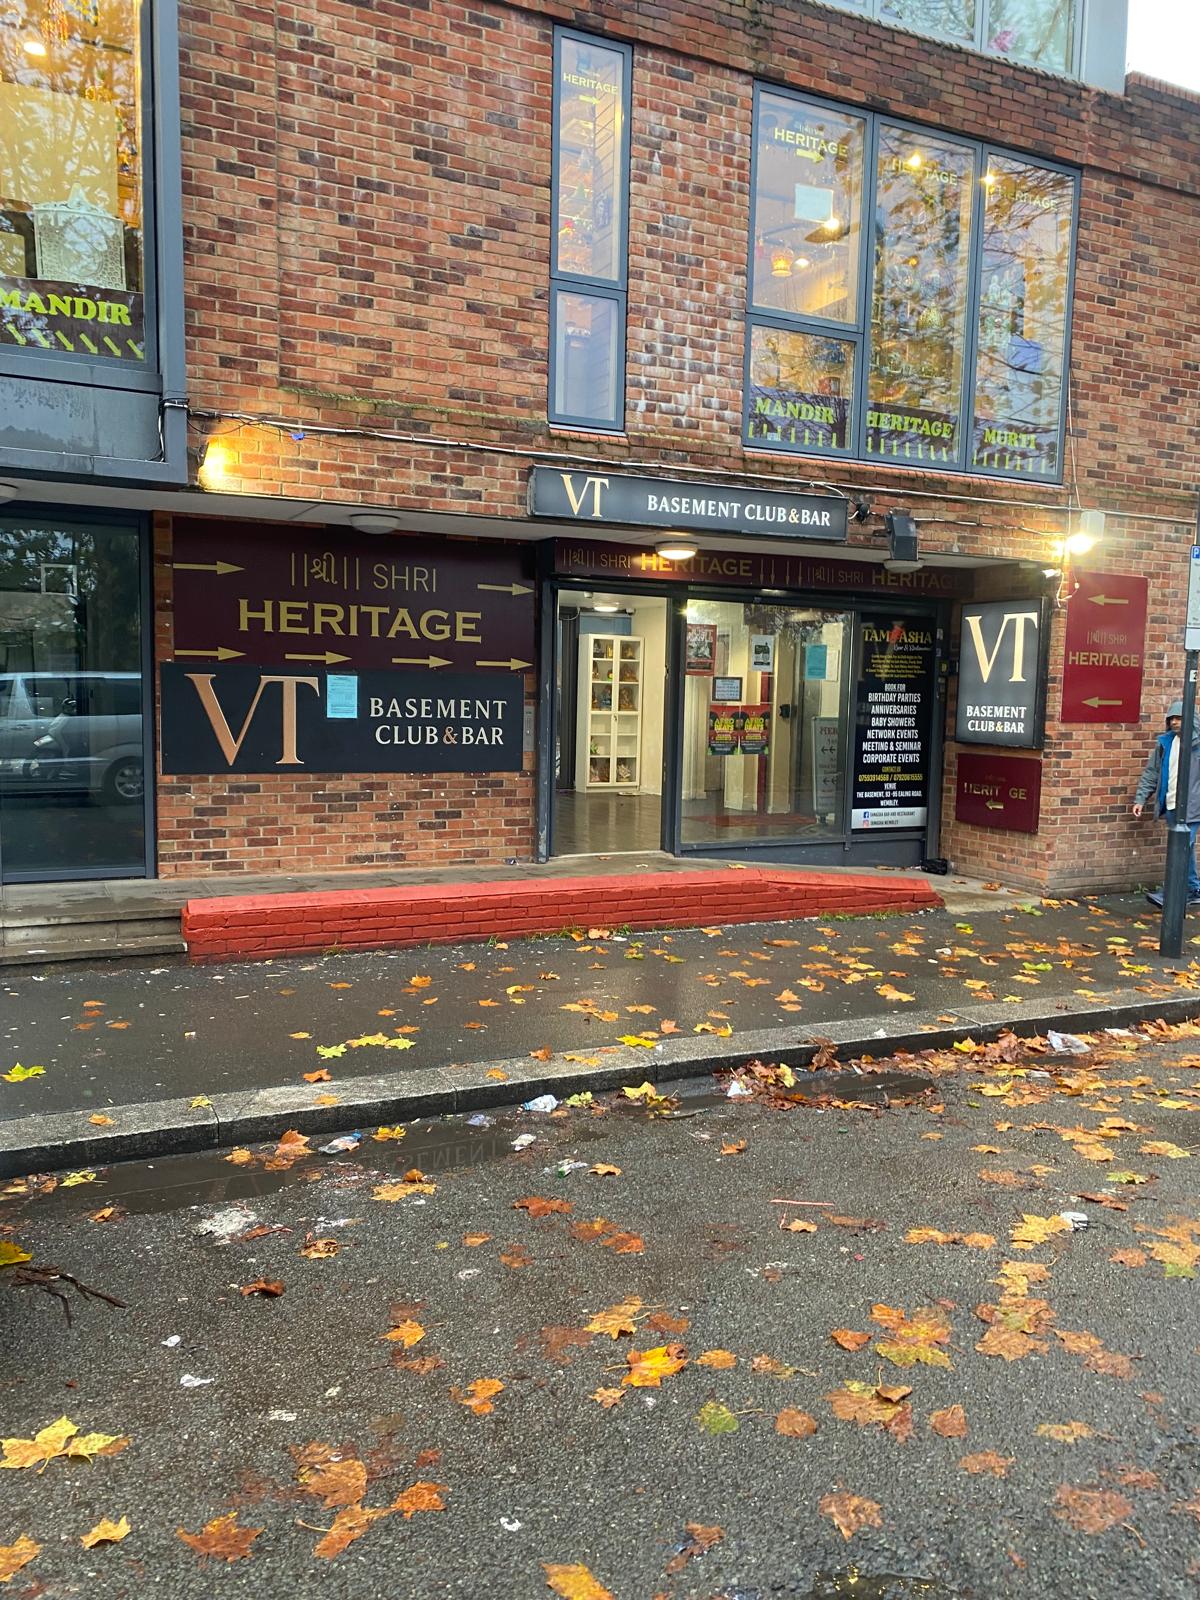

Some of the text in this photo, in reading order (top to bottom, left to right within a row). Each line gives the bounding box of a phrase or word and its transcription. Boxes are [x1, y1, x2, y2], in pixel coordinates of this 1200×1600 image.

[563, 72, 618, 95] HERITAGE
[774, 128, 848, 157] HERITAGE
[892, 158, 957, 186] HETAGE
[0, 287, 132, 326] MANDIR
[755, 397, 835, 424] MANDIR
[866, 410, 953, 438] HERITAGE
[984, 428, 1036, 450] MURTI
[560, 473, 609, 518] VT
[647, 494, 742, 519] BASEMENT
[599, 553, 631, 569] SHRI
[641, 552, 753, 577] HERITAGE
[373, 563, 436, 593] SHRI
[838, 570, 864, 584] SHRI
[238, 599, 482, 644] HERITAGE
[964, 612, 1038, 683] VT
[1108, 633, 1127, 646] SHRI
[1068, 650, 1140, 668] HERITAGE
[369, 697, 507, 720] BASEMENT
[868, 692, 921, 703] BIRTHDAY PARTIES
[184, 673, 320, 766] VT
[871, 705, 917, 715] ANNIVERSARIES
[966, 705, 1027, 719] BASEMENT
[871, 717, 916, 727] BABY SHOWERS
[867, 729, 919, 739] NETWORK EVENTS
[862, 741, 922, 751] MEETING & SEMINAR
[862, 753, 920, 763] CORPORATE EVENTS
[856, 791, 865, 799] THE
